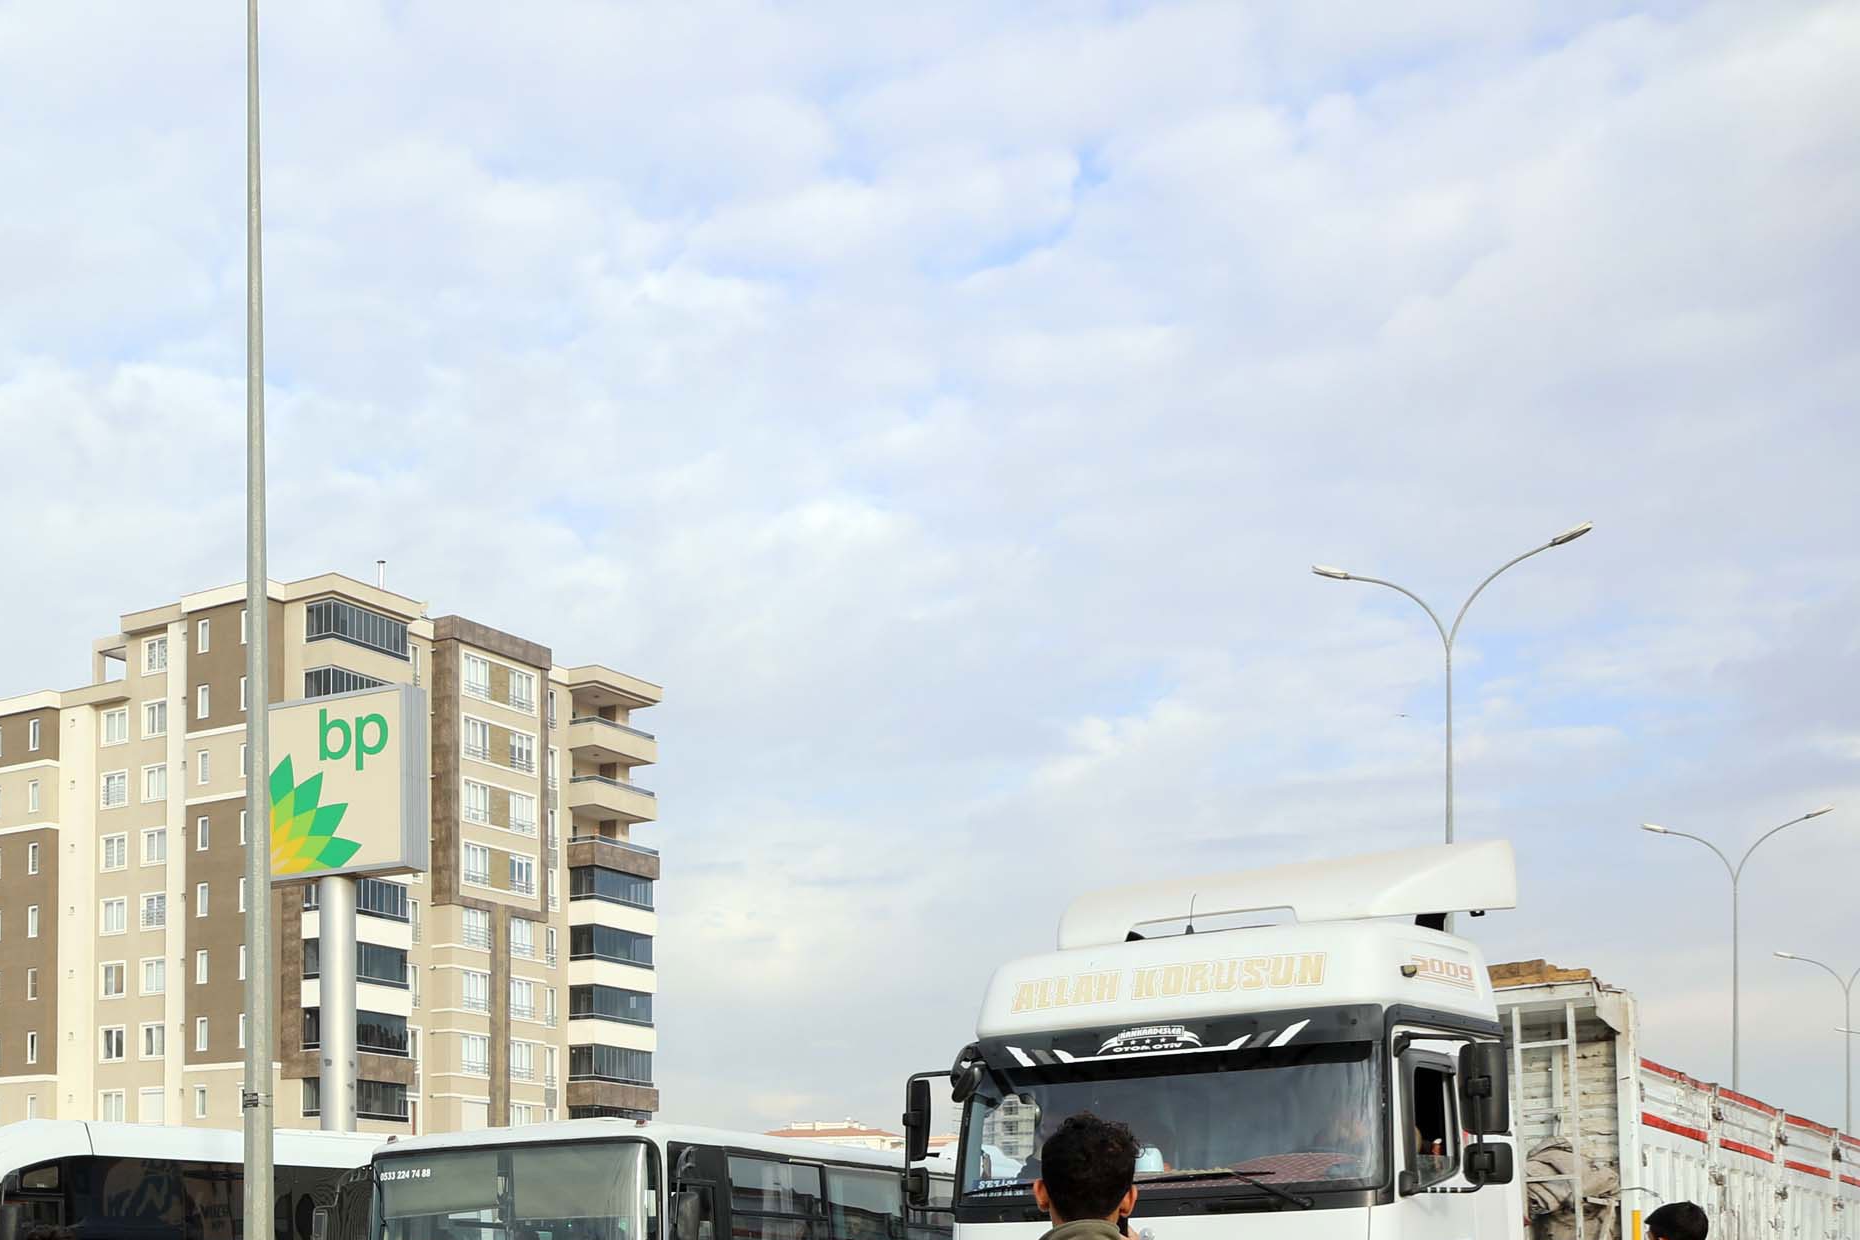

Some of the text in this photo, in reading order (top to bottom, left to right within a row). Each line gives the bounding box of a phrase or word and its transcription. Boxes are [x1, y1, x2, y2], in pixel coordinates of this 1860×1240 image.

[319, 708, 389, 771] bp
[1011, 953, 1326, 1014] ALLAH KORUSUN
[396, 1170, 410, 1180] 224
[411, 1169, 421, 1179] 74
